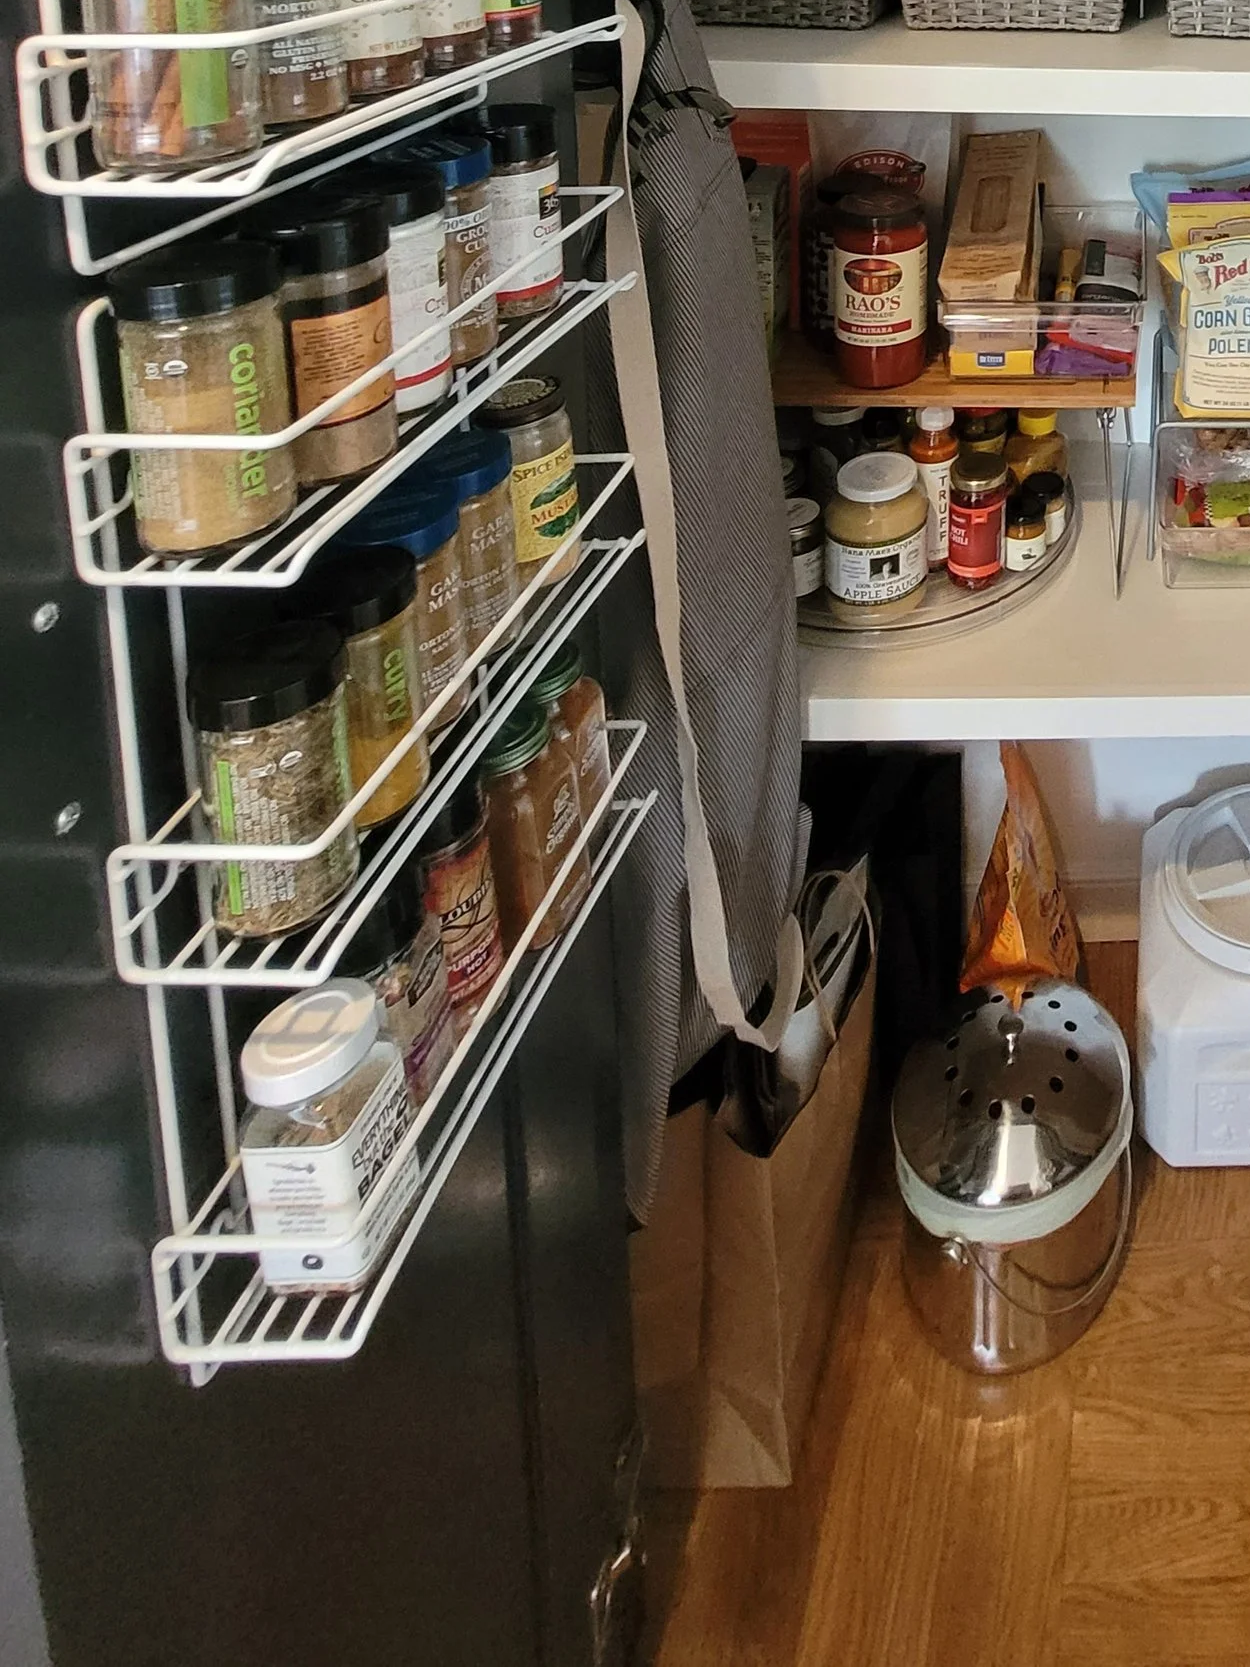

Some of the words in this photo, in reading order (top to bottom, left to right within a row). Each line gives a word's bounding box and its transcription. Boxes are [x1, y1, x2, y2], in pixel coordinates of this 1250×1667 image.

[854, 156, 905, 170] EDISON
[1215, 259, 1248, 291] Red
[845, 294, 901, 313] RAO'S
[851, 326, 893, 334] MARINARA
[1194, 309, 1237, 330] CORN
[512, 460, 553, 483] SPICE
[938, 474, 949, 542] TRUFF
[843, 585, 882, 601] APPLE
[886, 572, 922, 598] SAUCE
[383, 648, 409, 722] curry
[352, 1090, 404, 1170] EVERYTHIN
[358, 1112, 411, 1202] BAGEL
